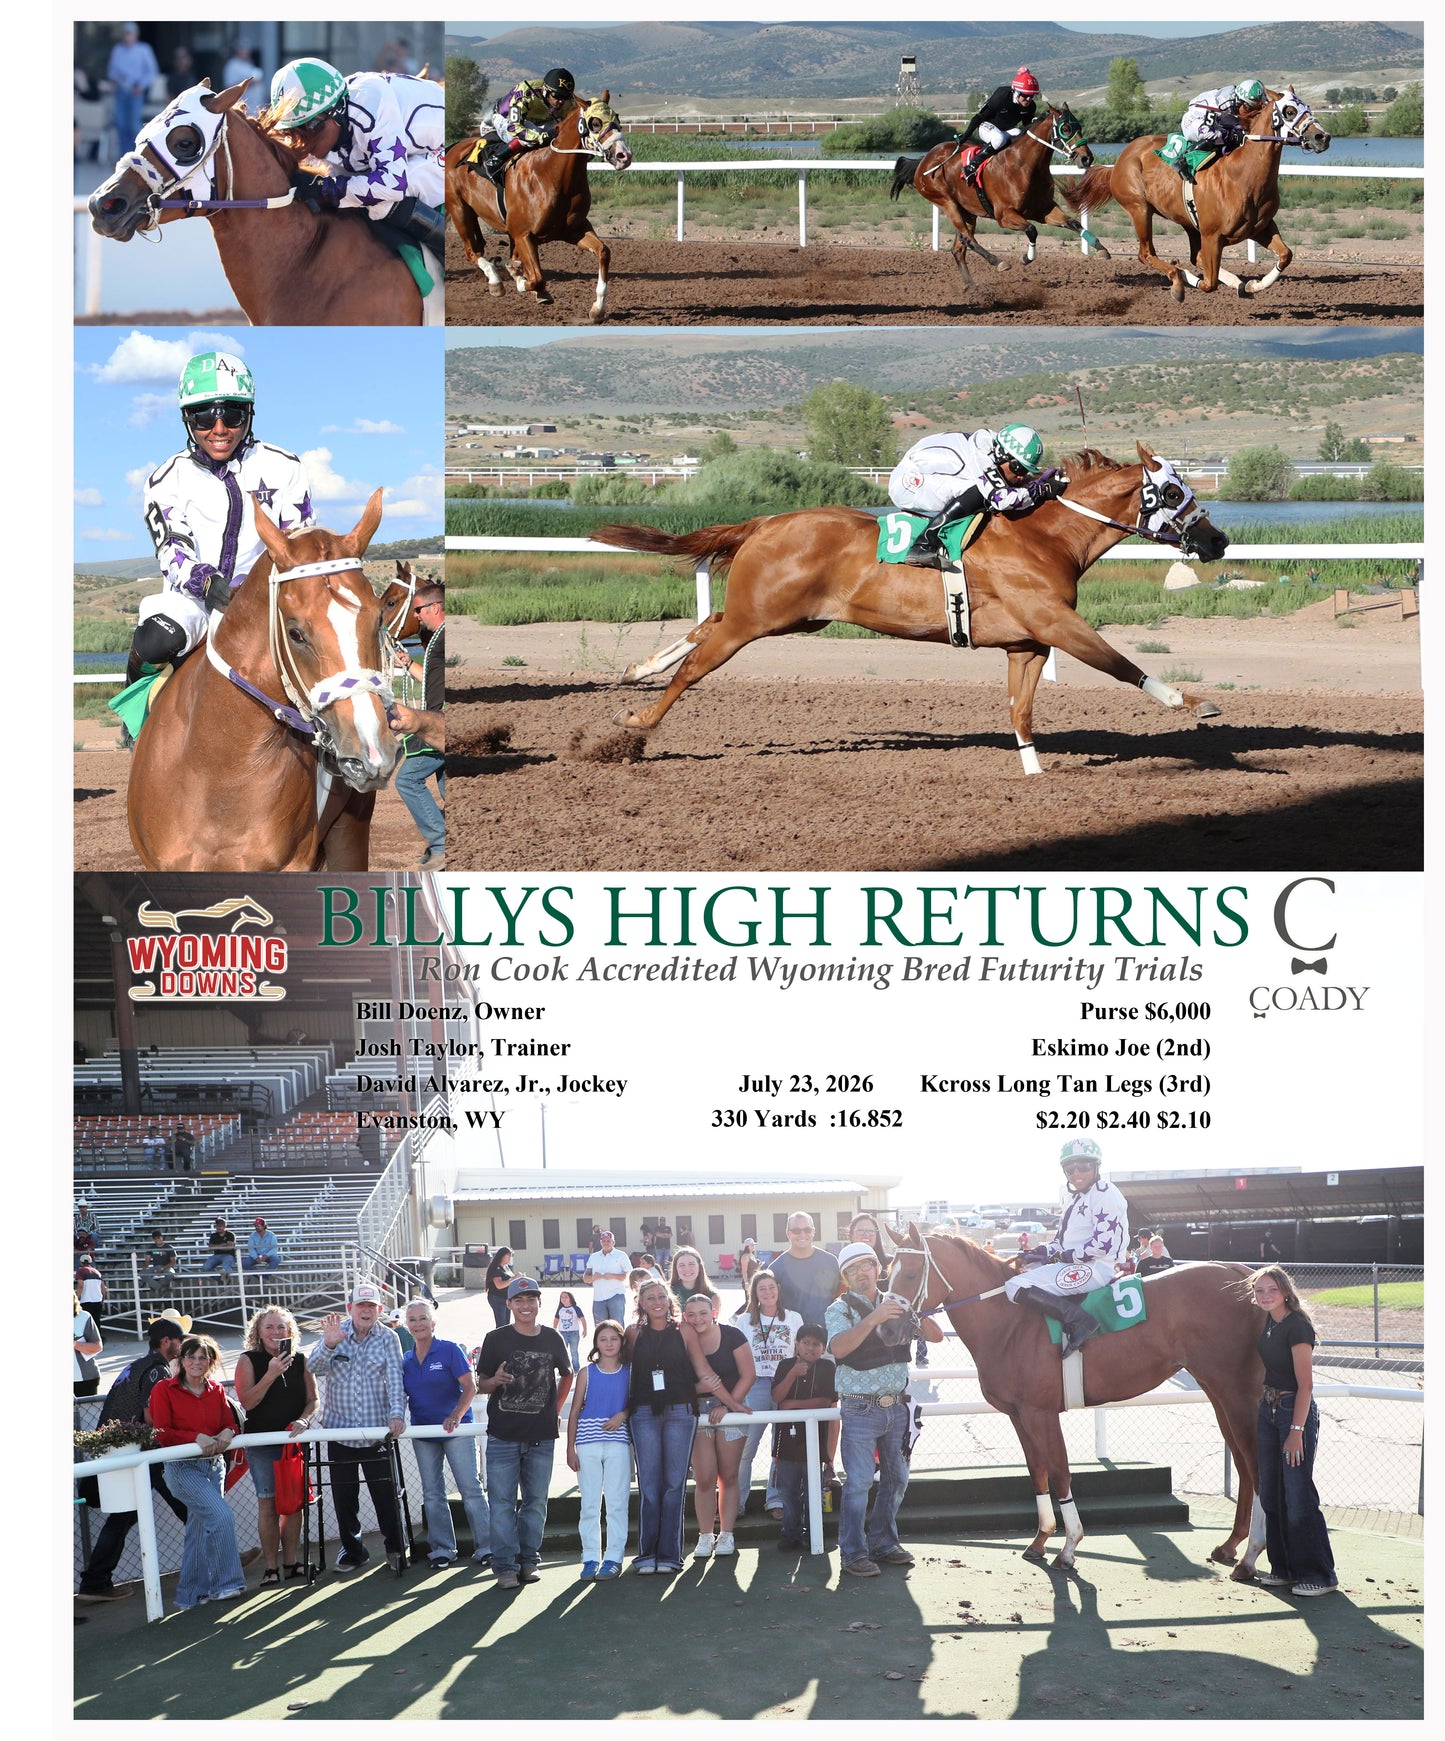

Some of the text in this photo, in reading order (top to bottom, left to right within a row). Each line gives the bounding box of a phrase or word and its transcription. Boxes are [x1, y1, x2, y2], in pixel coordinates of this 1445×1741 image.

[510, 108, 519, 123] 6
[1205, 112, 1216, 127] 5
[1273, 111, 1280, 127] 5
[577, 118, 585, 135] 6
[1161, 133, 1183, 159] 5
[986, 469, 1006, 488] 5
[258, 490, 271, 501] JT
[1142, 484, 1157, 508] 5
[148, 506, 166, 548] 5
[886, 512, 912, 554] 5
[1111, 1278, 1143, 1319] 5
